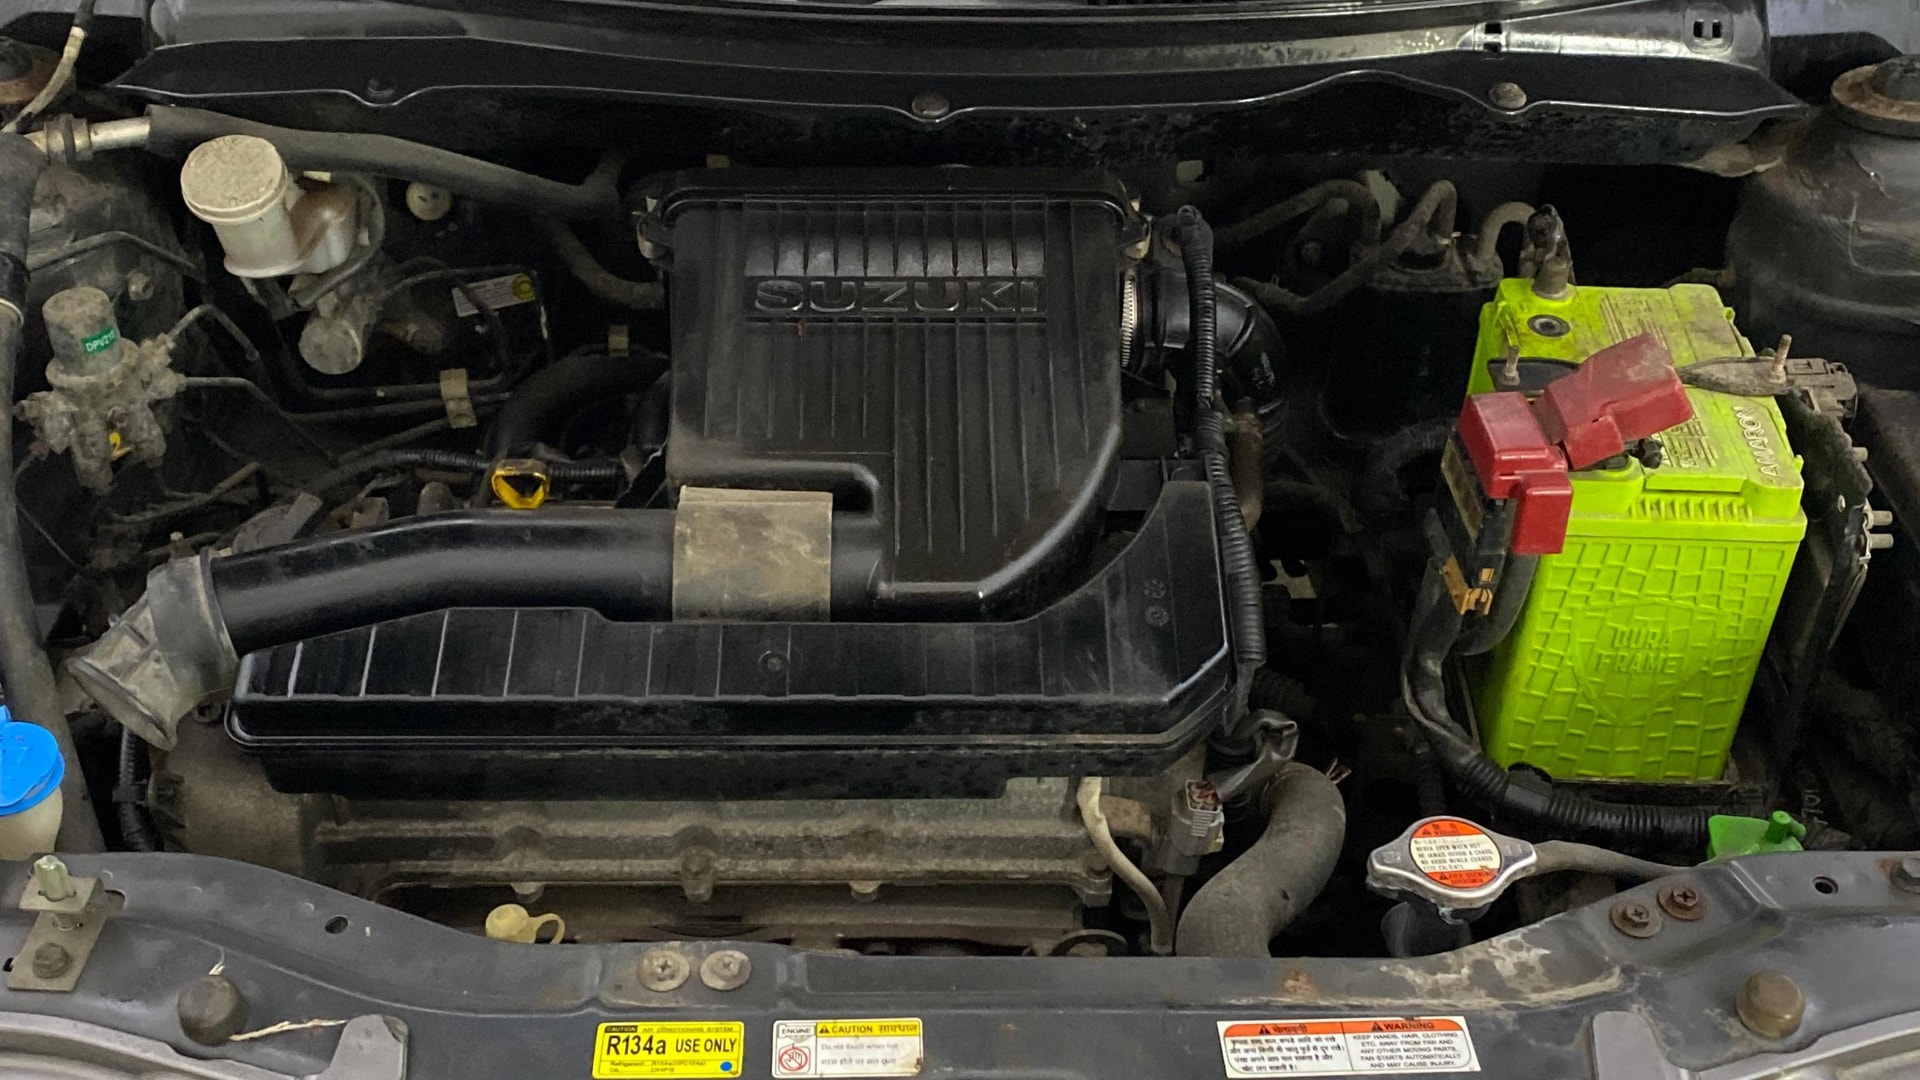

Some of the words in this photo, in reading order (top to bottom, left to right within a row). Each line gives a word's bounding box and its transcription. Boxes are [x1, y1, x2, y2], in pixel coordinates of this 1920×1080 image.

[755, 280, 1038, 312] SUZUKI
[1733, 406, 1779, 477] AMARON
[1595, 652, 1681, 673] FRAME
[1384, 1022, 1435, 1030] WARNING
[606, 1034, 666, 1055] R134a
[676, 1038, 701, 1052] USE
[704, 1038, 737, 1052] ONLY
